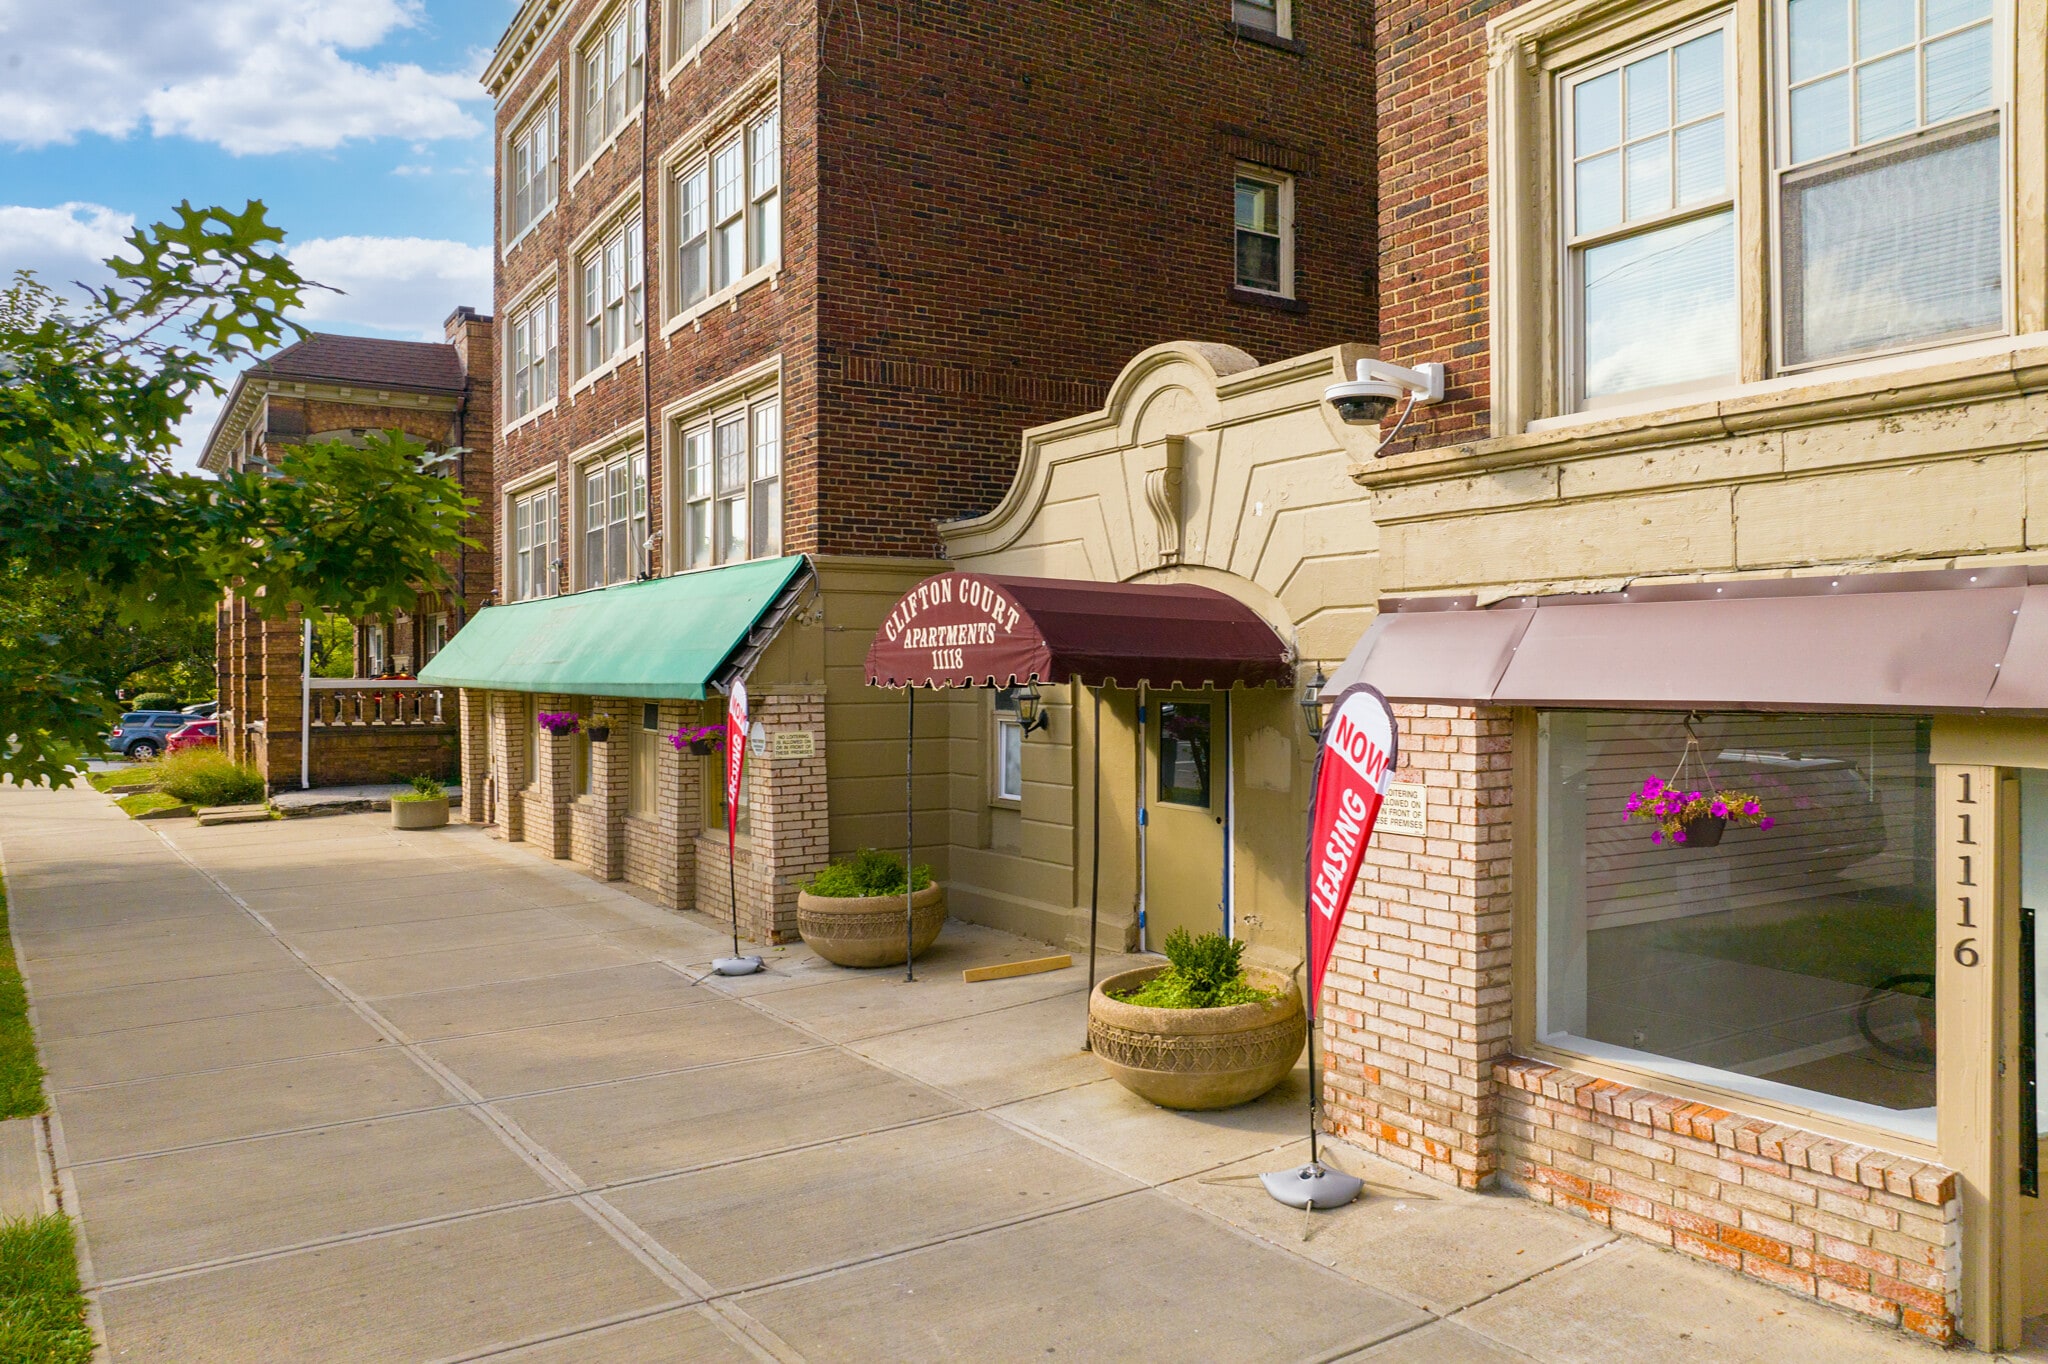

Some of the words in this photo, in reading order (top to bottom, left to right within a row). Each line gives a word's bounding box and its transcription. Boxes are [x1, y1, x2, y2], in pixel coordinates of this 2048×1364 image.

[885, 577, 953, 642] CLIFTON
[959, 577, 1020, 635] COURT
[903, 622, 996, 649] APARTMENTS
[931, 647, 964, 670] 11118
[1335, 713, 1390, 784] NOW
[1385, 789, 1418, 799] OITERING
[1411, 800, 1421, 809] ON
[1376, 816, 1388, 825] ESE
[1390, 818, 1423, 829] PREMISES
[1389, 808, 1410, 817] FRONT
[1412, 810, 1421, 819] OF
[1311, 788, 1367, 921] LEASING
[1953, 772, 1979, 968] 11116
